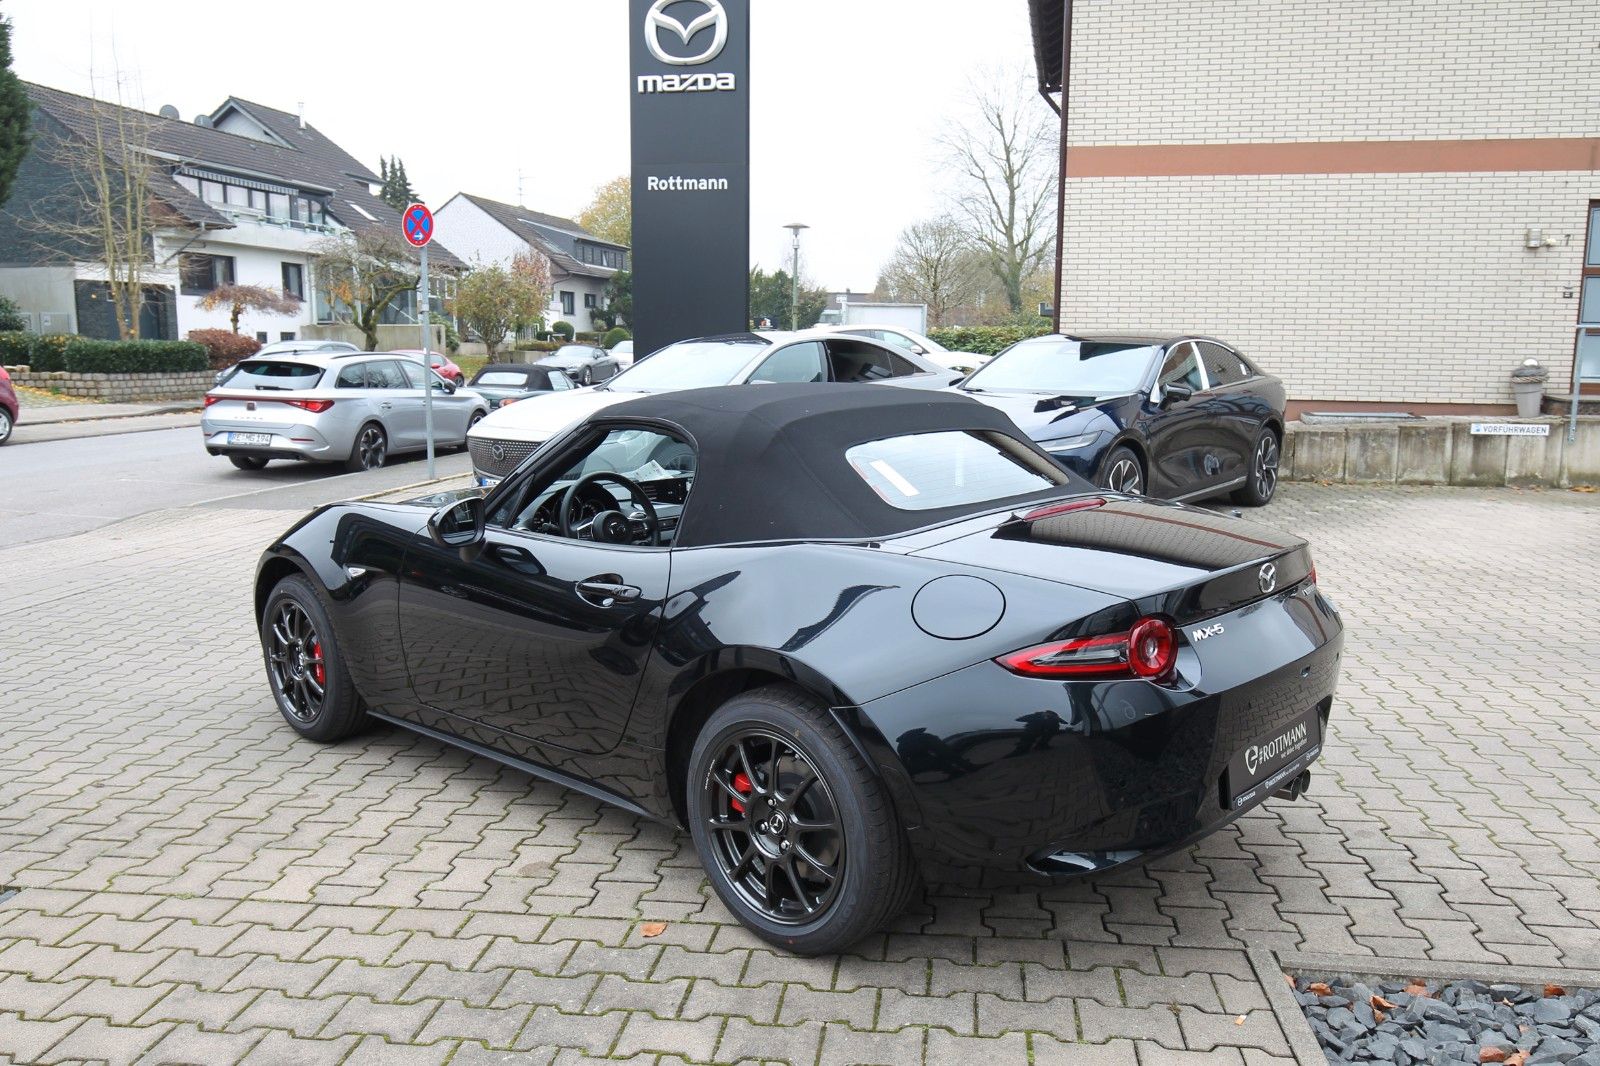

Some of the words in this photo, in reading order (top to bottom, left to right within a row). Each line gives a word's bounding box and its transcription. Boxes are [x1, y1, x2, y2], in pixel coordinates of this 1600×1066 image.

[647, 176, 728, 191] Rottmann
[1483, 425, 1547, 434] VORFÜHRWAGEN
[1192, 623, 1225, 642] MX-5
